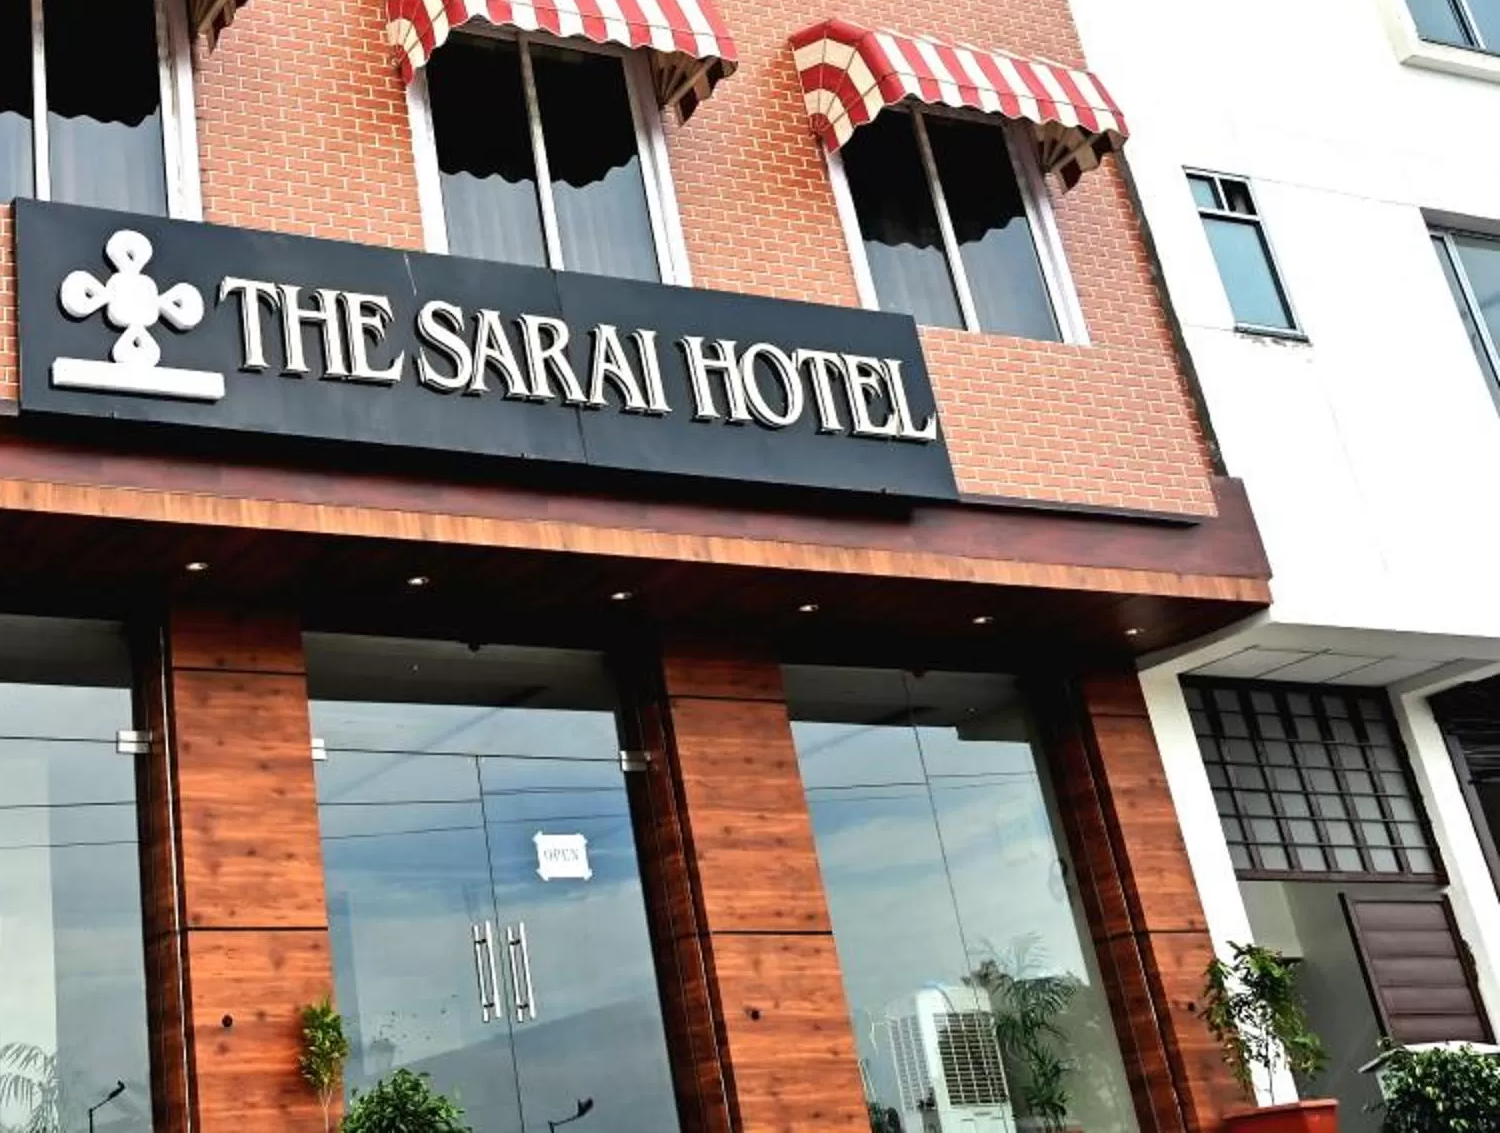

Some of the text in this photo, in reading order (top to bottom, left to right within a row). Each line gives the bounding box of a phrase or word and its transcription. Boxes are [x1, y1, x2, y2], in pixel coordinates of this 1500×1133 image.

[218, 275, 938, 441] THE SARAI HOTEL
[543, 848, 579, 862] OPEN
